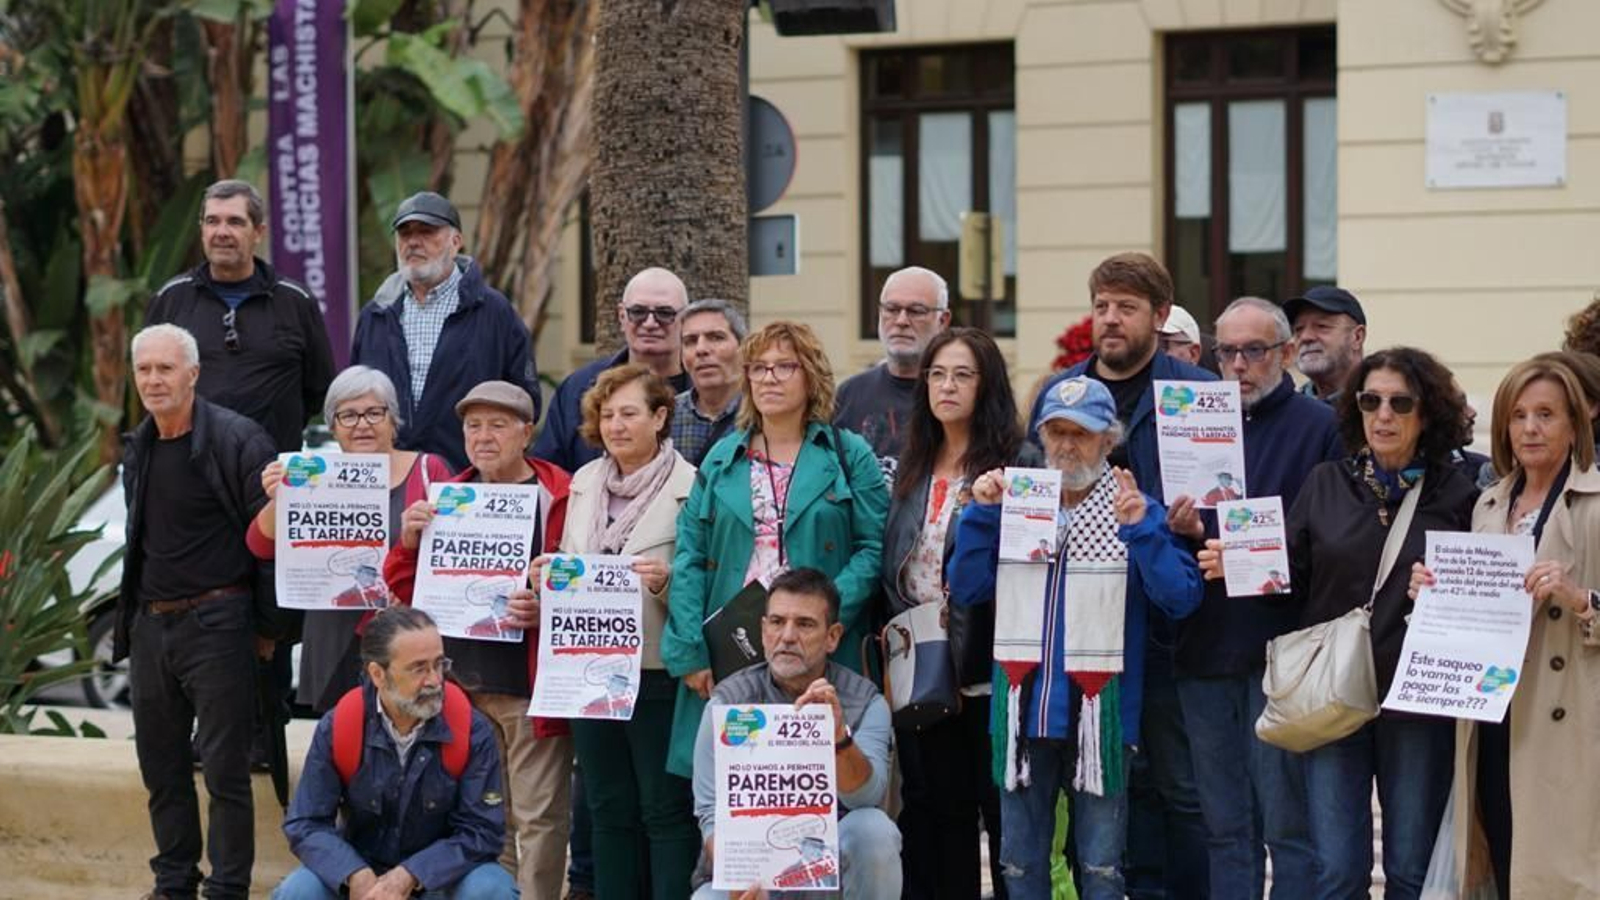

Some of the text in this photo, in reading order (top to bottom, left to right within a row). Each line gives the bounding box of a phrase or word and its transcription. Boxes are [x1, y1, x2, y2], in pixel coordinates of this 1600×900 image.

[272, 45, 304, 252] CONTRA LAS
[297, 144, 326, 314] IOLENCIAS
[1197, 396, 1228, 408] 42%
[337, 468, 377, 483] 42%
[484, 498, 524, 513] 42%
[288, 511, 383, 527] PAREMOS
[288, 528, 386, 541] EL TARIFAZO
[432, 539, 524, 557] PAREMOS
[430, 556, 526, 571] EL TARIFAZO
[1467, 567, 1474, 575] 12
[594, 571, 630, 587] 42%
[551, 616, 636, 633] PAREMOS
[551, 634, 640, 648] EL TARIFAZO
[1410, 651, 1483, 672] Este saqueo
[1406, 664, 1417, 677] lo
[1421, 670, 1461, 682] vamos
[1464, 675, 1473, 683] a
[1401, 681, 1460, 694] pagar las
[1397, 690, 1488, 710] de siempre???
[777, 721, 820, 739] 42%
[787, 763, 825, 771] PERMITIR
[728, 773, 829, 791] PAREMOS
[728, 793, 834, 808] EL TARIFAZO
